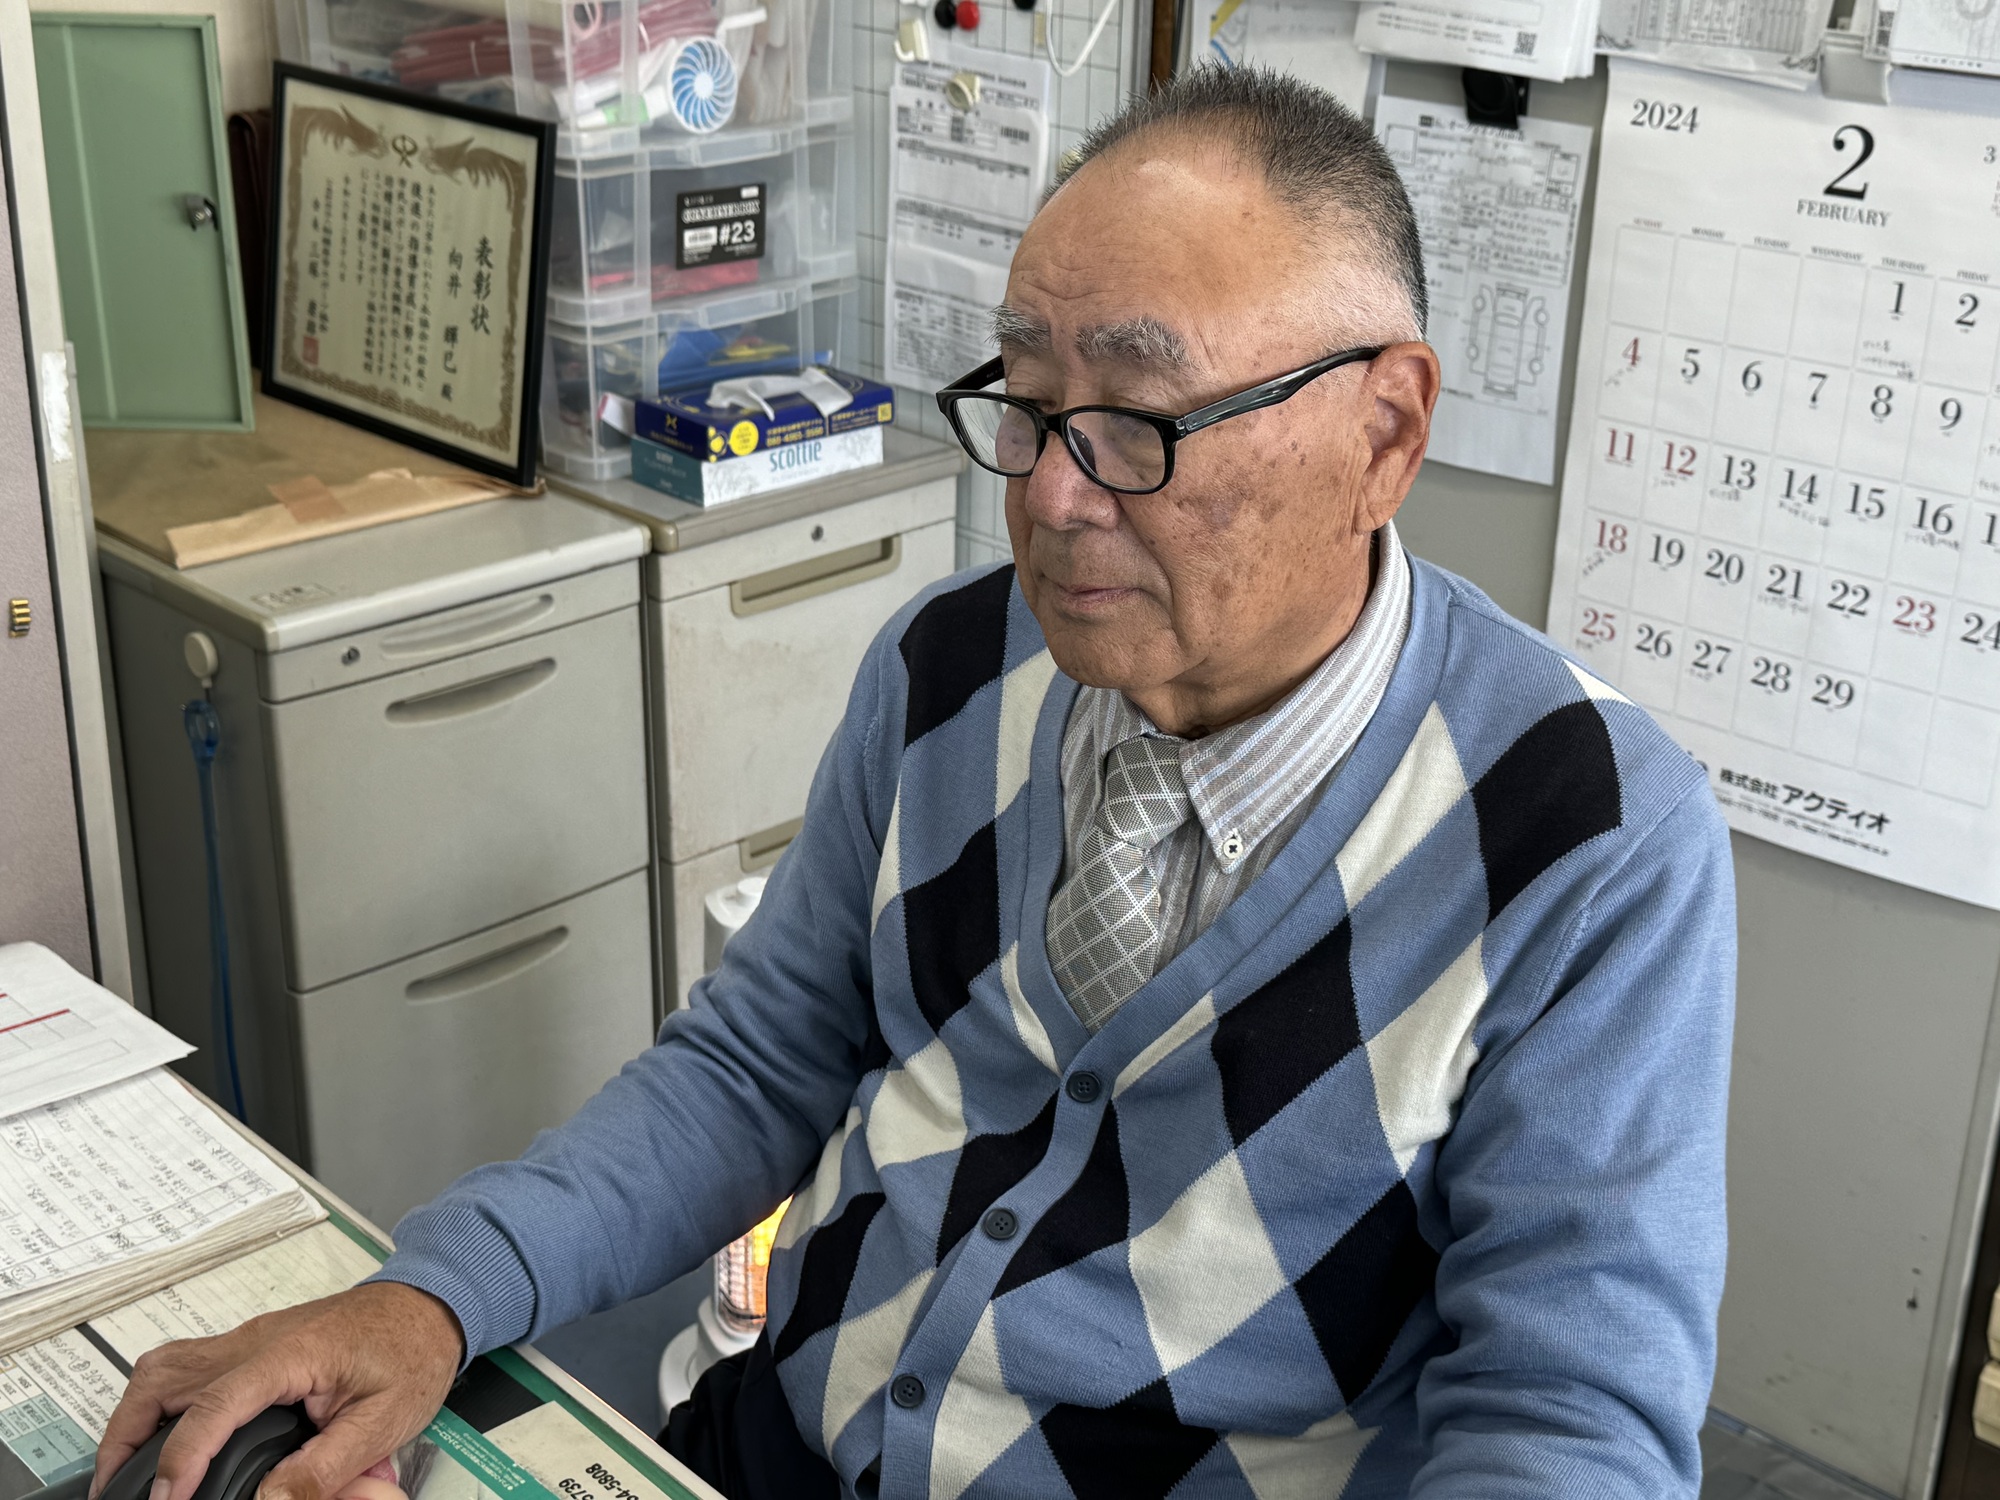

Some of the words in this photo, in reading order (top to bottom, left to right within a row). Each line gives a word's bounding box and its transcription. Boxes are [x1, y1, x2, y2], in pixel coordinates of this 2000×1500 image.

[1631, 99, 1699, 133] 2024
[1823, 124, 1875, 201] 2
[1984, 145, 1996, 164] 3
[719, 219, 756, 246] #23
[1797, 199, 1890, 228] FEBRUARY
[471, 235, 494, 336] 表彰状
[1889, 281, 1906, 316] 1
[1954, 293, 1980, 328] 2
[1622, 337, 1641, 367] 4
[1680, 348, 1701, 379] 5
[1741, 360, 1764, 392] 6
[1807, 372, 1828, 404] 7
[1870, 385, 1893, 418] 8
[1938, 398, 1963, 430] 9
[770, 441, 822, 472] scottie
[1605, 428, 1636, 462] 11
[1661, 441, 1697, 476] 12
[1719, 455, 1757, 490] 13
[1779, 468, 1819, 505] 14
[1845, 482, 1886, 519] 15
[1912, 497, 1955, 535] 16
[1594, 519, 1628, 554] 18
[1649, 534, 1685, 567] 19
[1705, 549, 1745, 584] 20
[1765, 564, 1803, 601] 21
[1826, 579, 1871, 617] 22
[1892, 595, 1937, 633] 23
[1959, 612, 2000, 651] 24
[1581, 608, 1616, 641] 25
[1635, 623, 1673, 658] 26
[1692, 640, 1732, 675] 27
[1750, 656, 1793, 693] 28
[1811, 673, 1855, 710] 29
